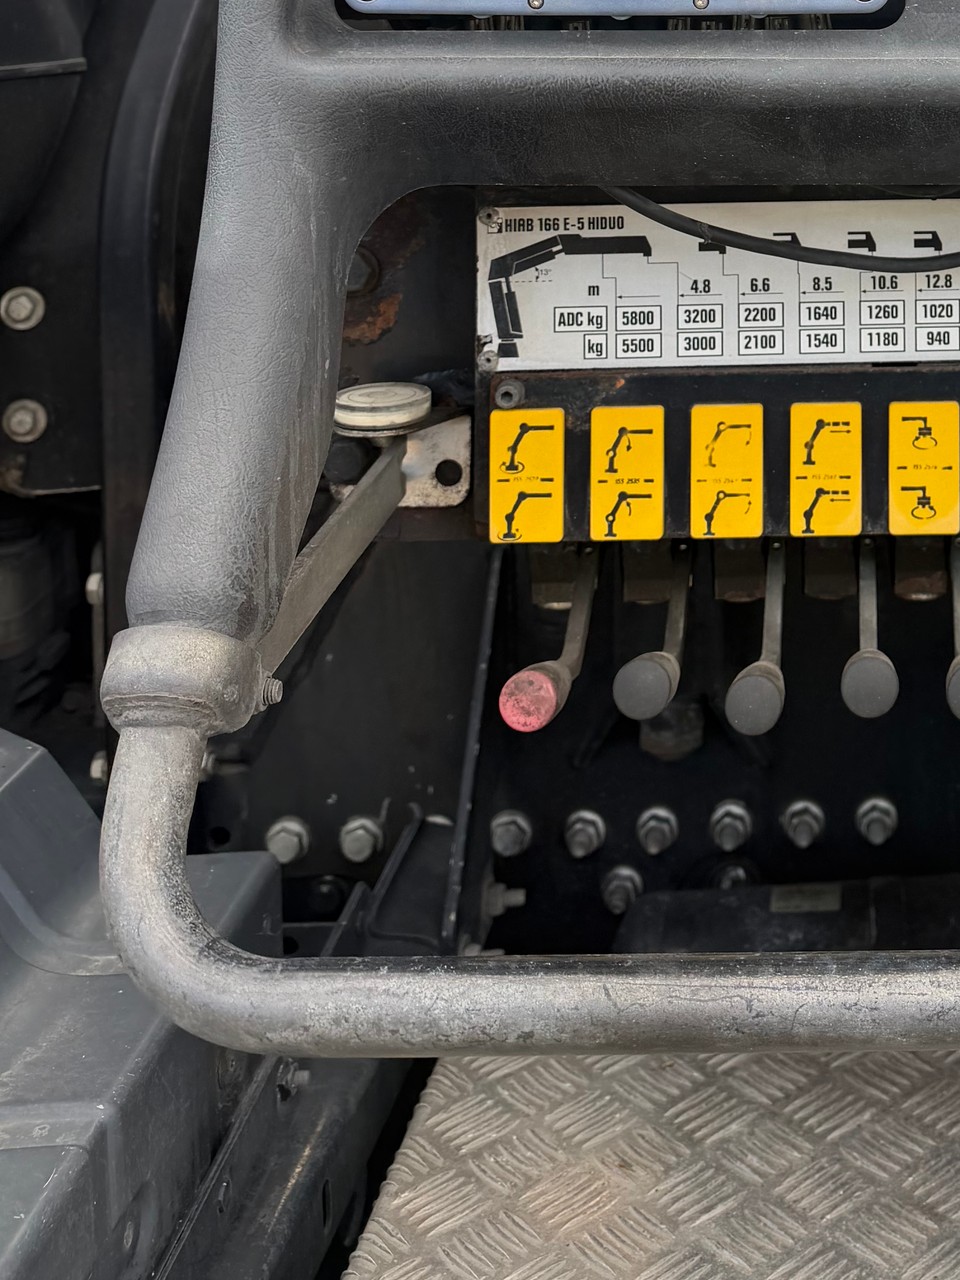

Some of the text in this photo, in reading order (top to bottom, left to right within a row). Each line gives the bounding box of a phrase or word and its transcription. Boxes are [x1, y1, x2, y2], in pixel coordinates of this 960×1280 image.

[505, 216, 624, 232] HIAB 166 E-5 HIDUO
[588, 285, 600, 296] m
[690, 279, 711, 293] 4.8
[750, 278, 770, 292] 6.6
[812, 277, 832, 291] 8.5
[870, 276, 898, 290] 10.6
[925, 274, 953, 288] 12.8
[558, 312, 585, 327] ADC
[588, 311, 603, 328] kg
[622, 311, 654, 326] 5800
[684, 308, 716, 323] 3200
[744, 307, 776, 322] 2200
[806, 306, 837, 320] 1640
[867, 305, 898, 319] 1260
[922, 304, 953, 318] 1020
[588, 339, 603, 356] kg
[622, 338, 654, 353] 5500
[684, 336, 716, 350] 3000
[744, 335, 776, 349] 2100
[806, 334, 838, 347] 1540
[867, 332, 898, 346] 1180
[926, 332, 950, 346] 940
